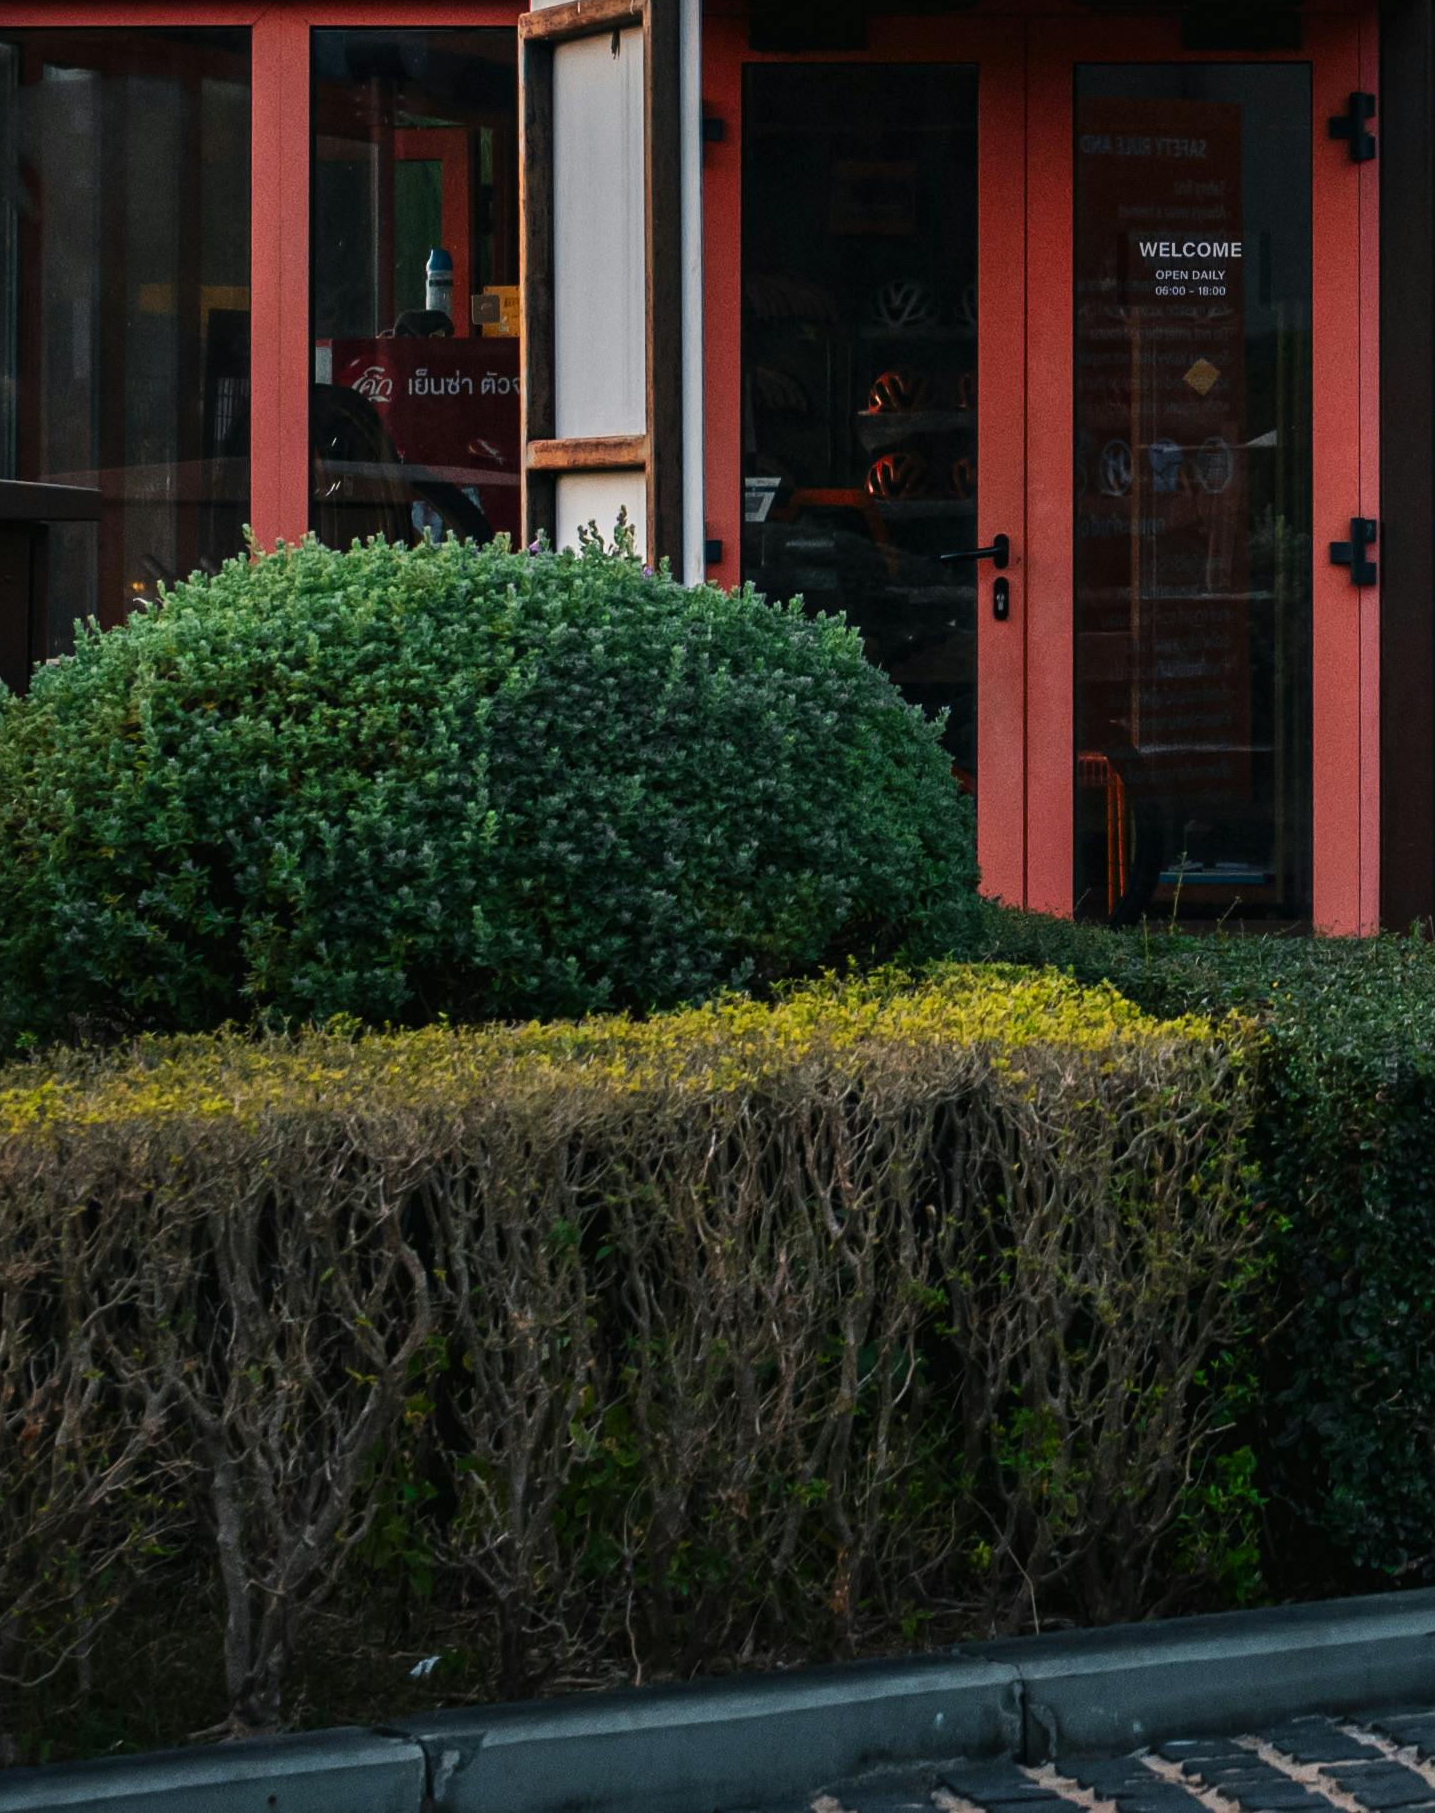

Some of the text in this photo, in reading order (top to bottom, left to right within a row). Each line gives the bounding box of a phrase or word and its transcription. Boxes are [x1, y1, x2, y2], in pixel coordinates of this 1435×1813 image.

[1138, 242, 1243, 259] WELCOME
[1155, 270, 1226, 281] OPEN DAILY
[1155, 286, 1187, 296] 06:00
[1199, 286, 1226, 296] 18:00
